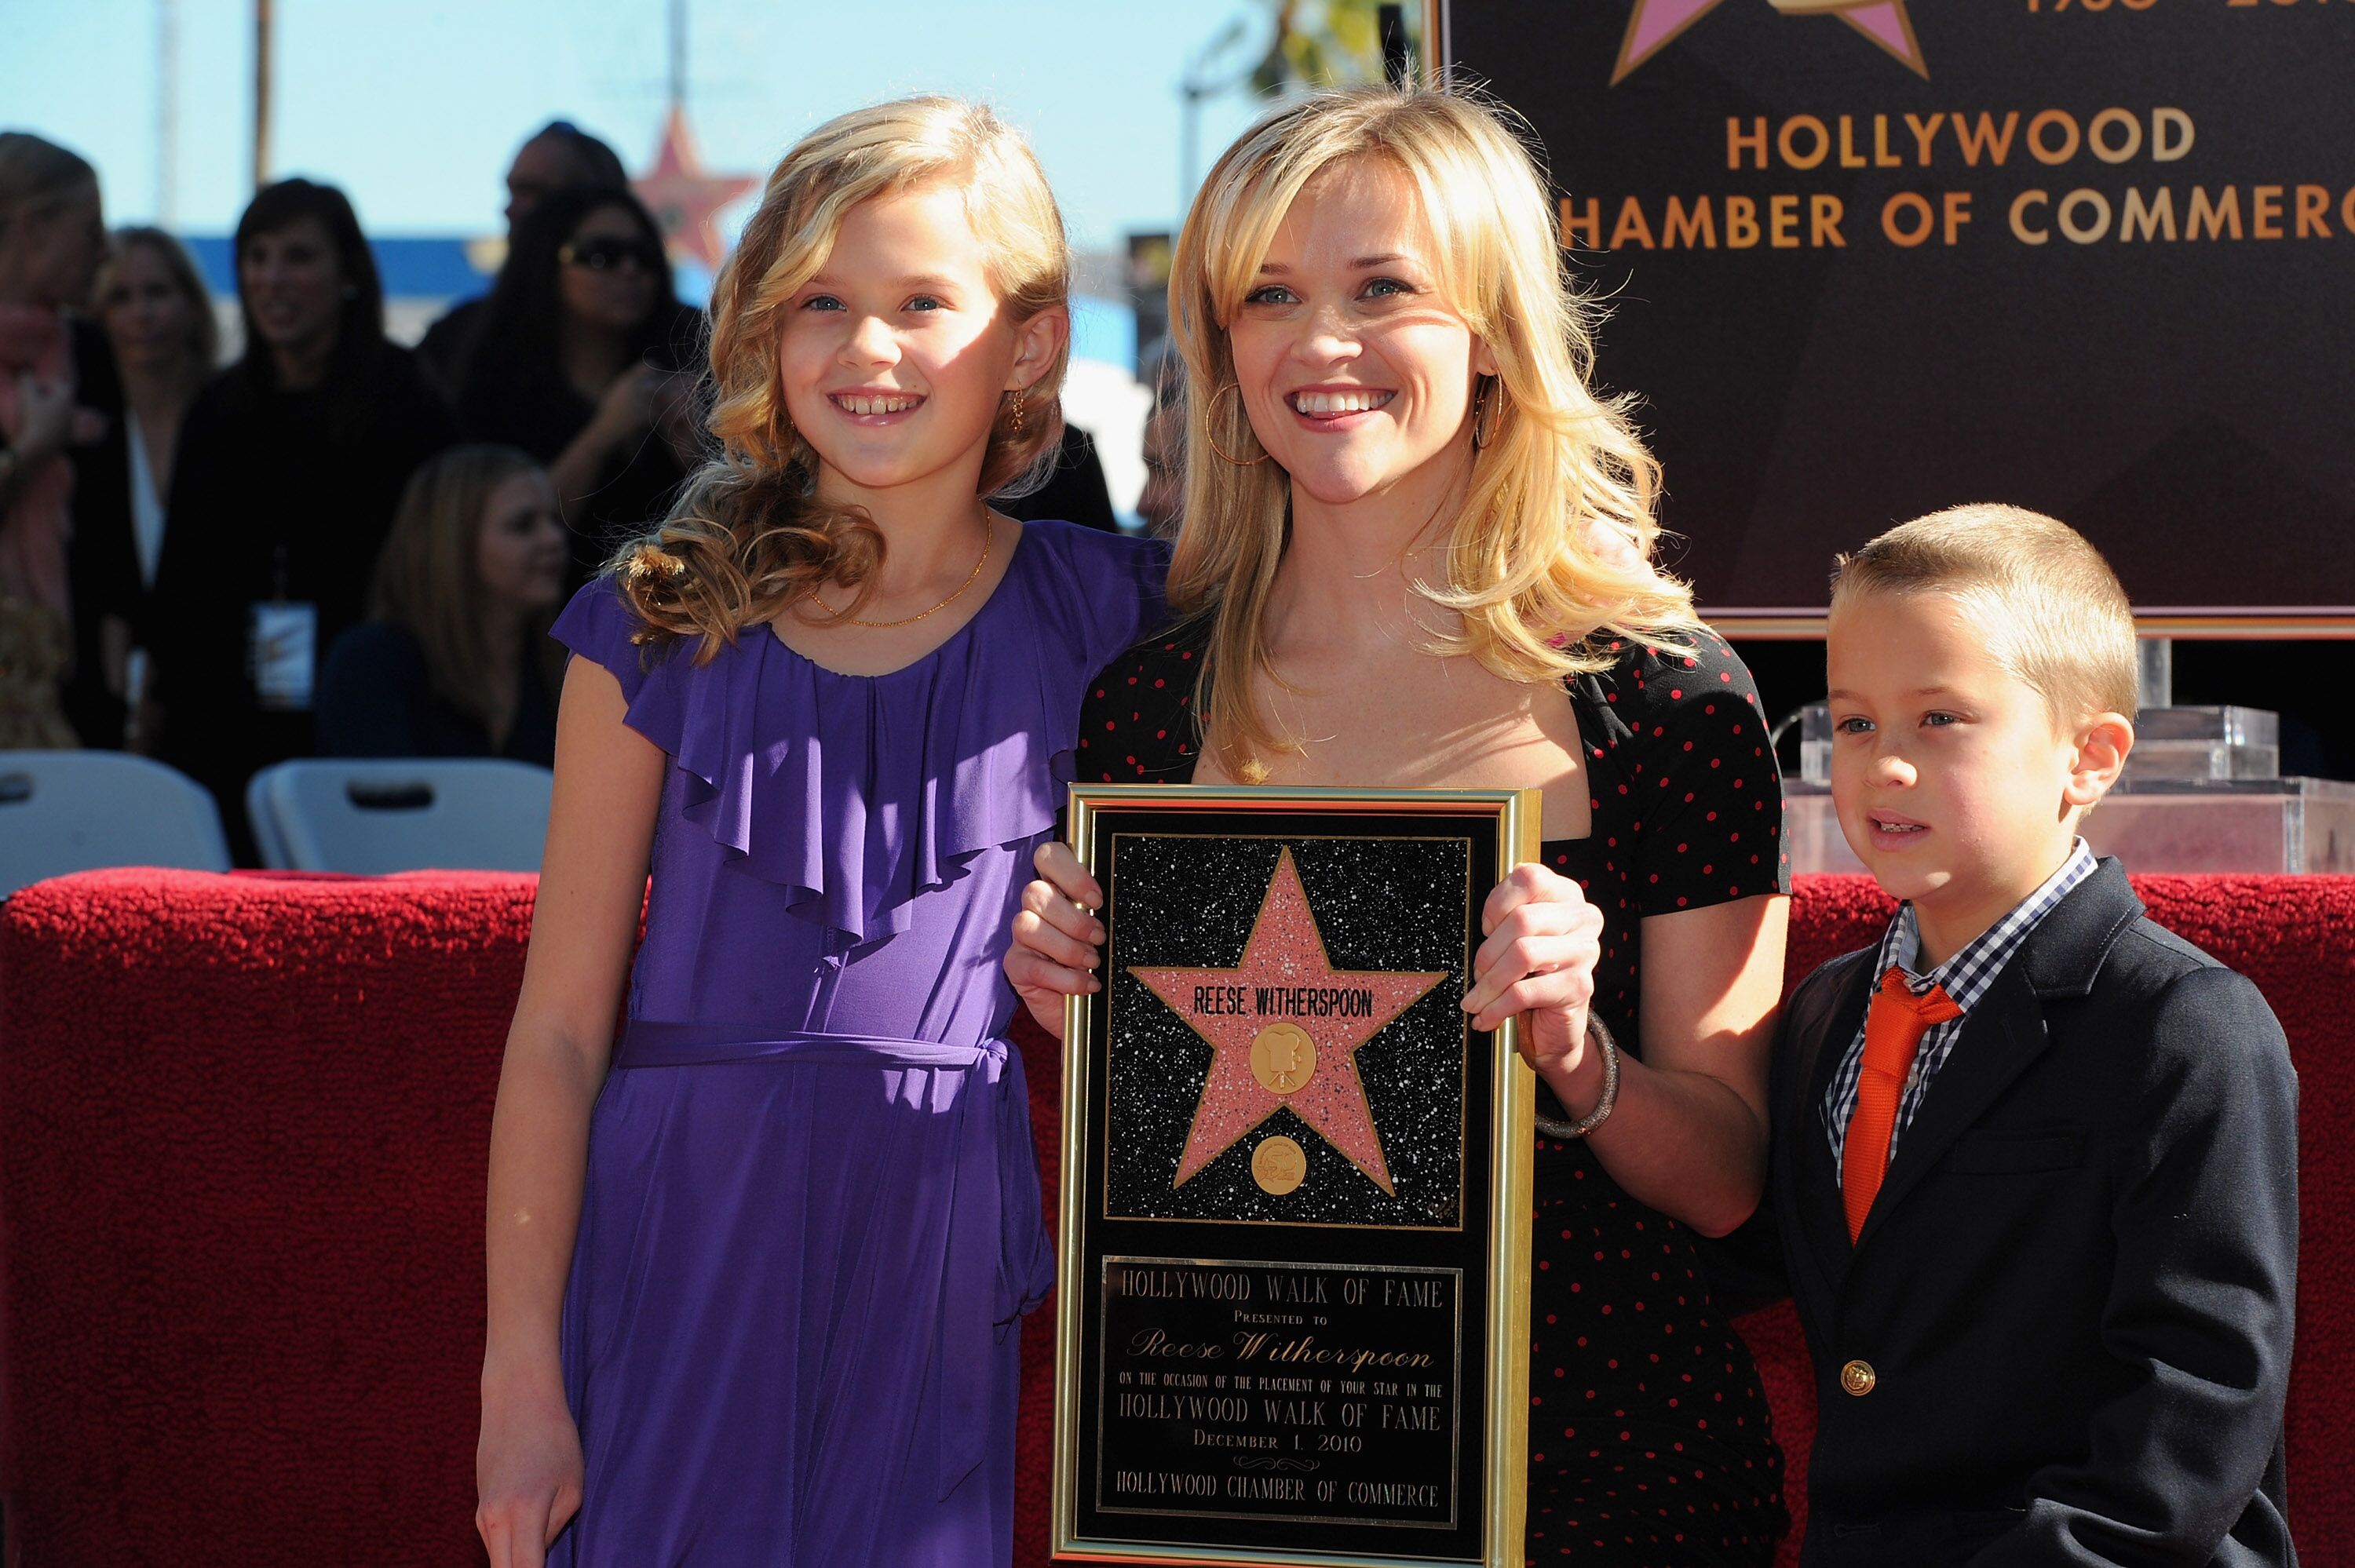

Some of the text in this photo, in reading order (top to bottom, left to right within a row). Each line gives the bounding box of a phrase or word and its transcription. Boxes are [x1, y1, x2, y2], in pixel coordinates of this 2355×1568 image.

[1726, 107, 2196, 170] HOLLYWOOD
[1559, 194, 1846, 250] HAMBER
[1882, 191, 1972, 246] OF
[1194, 986, 1372, 1018] REESE WITHERSPOON
[1122, 1270, 1443, 1308] HOLLYWOOD WALK OF FAME
[1126, 1328, 1434, 1373] Reese Witherspoon
[1119, 1372, 1443, 1398] ON THE OCCASION OF THE PLACEMENT OF YOUR STAR IN THE
[1119, 1393, 1440, 1431] HOLLYWOOD WALK OF FAME
[1318, 1435, 1362, 1452] 2010
[1117, 1471, 1439, 1508] HOLLYWOOD CHAMBER OF COMMERCE
